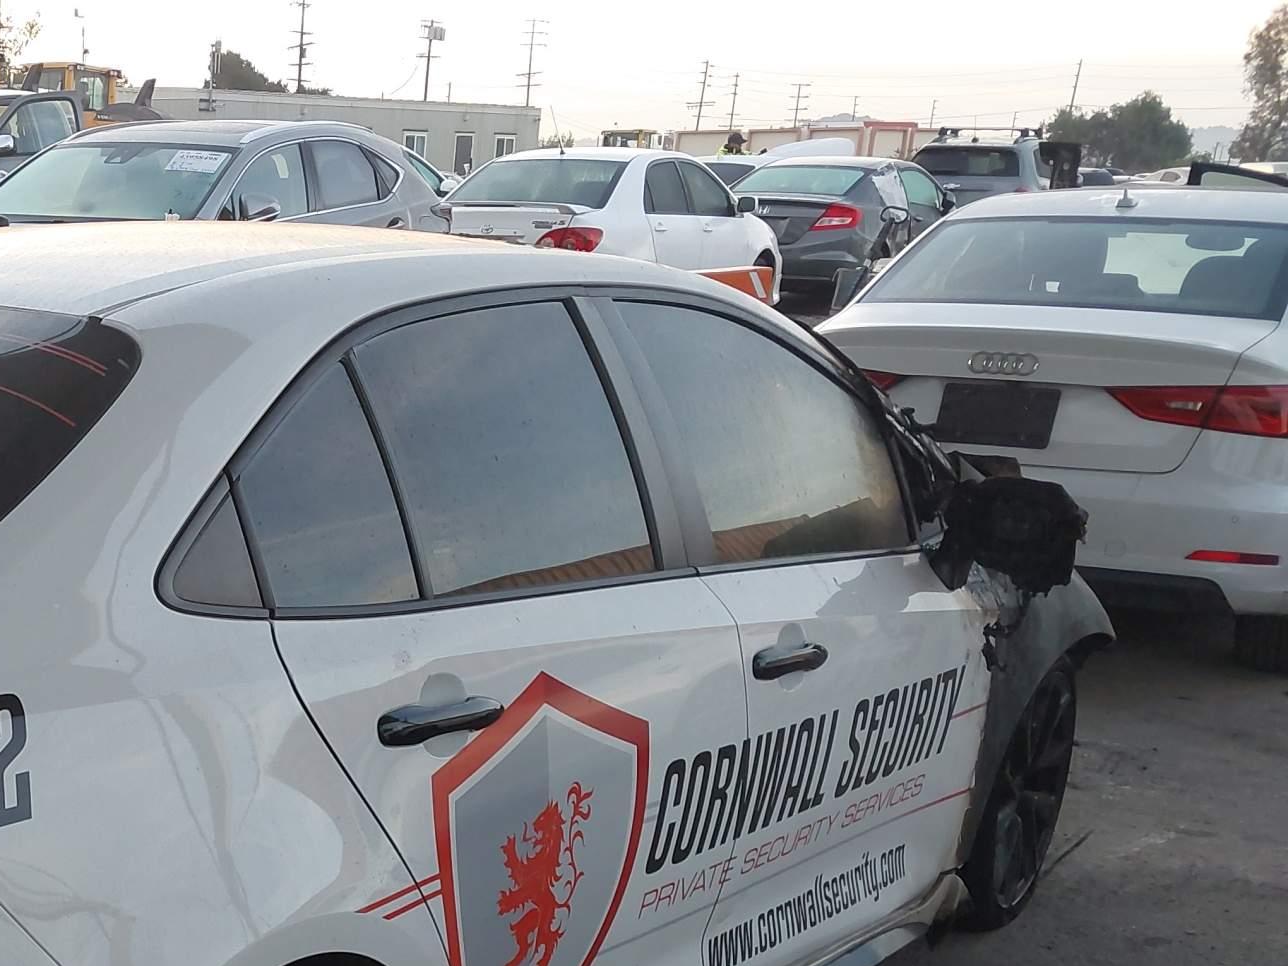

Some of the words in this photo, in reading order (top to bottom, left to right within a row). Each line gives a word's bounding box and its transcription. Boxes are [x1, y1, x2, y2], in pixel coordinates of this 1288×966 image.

[637, 856, 738, 920] PRIVATE
[740, 814, 841, 876] SECURITY
[841, 774, 926, 829] SERVICES
[645, 708, 839, 875] CORNWALL
[833, 664, 966, 799] SECURITY
